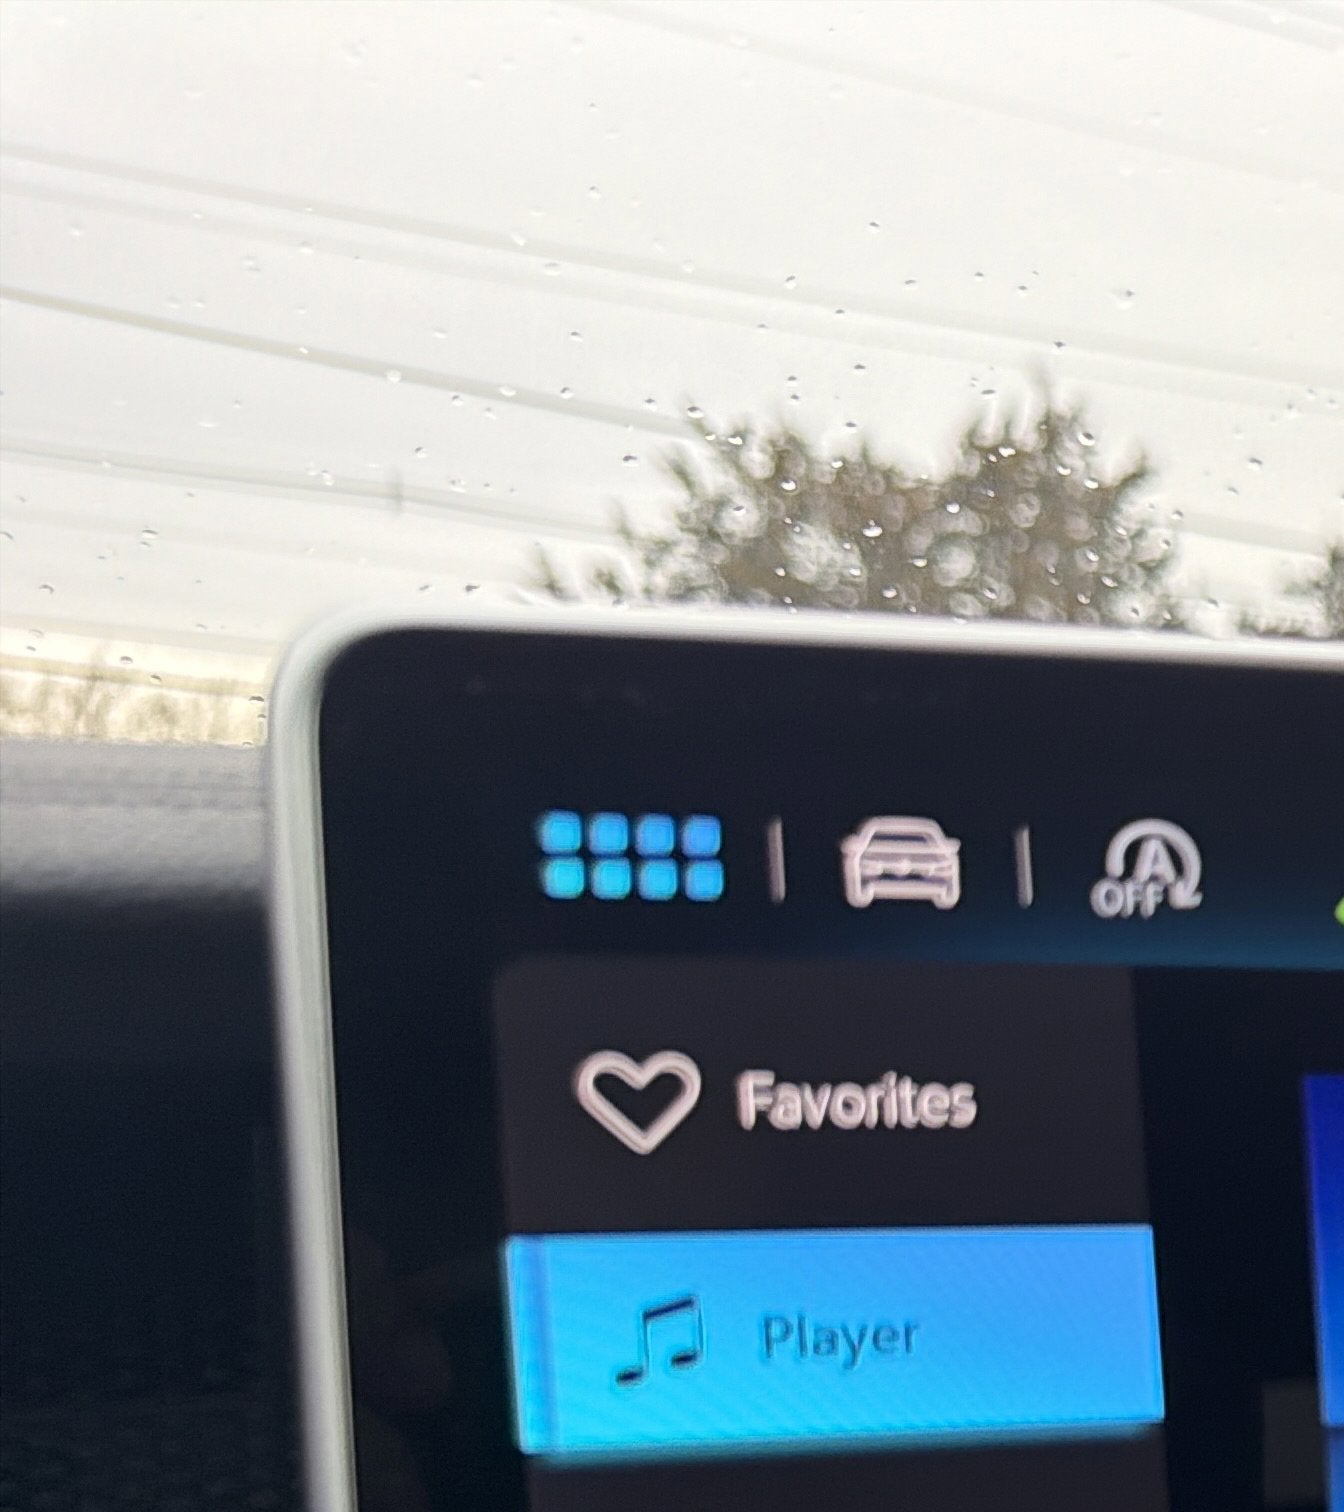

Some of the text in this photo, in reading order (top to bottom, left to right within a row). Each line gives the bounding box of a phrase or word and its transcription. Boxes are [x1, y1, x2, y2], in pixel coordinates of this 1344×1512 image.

[1090, 877, 1166, 918] OFF
[737, 1070, 978, 1130] Favorites
[757, 1312, 922, 1371] Player
